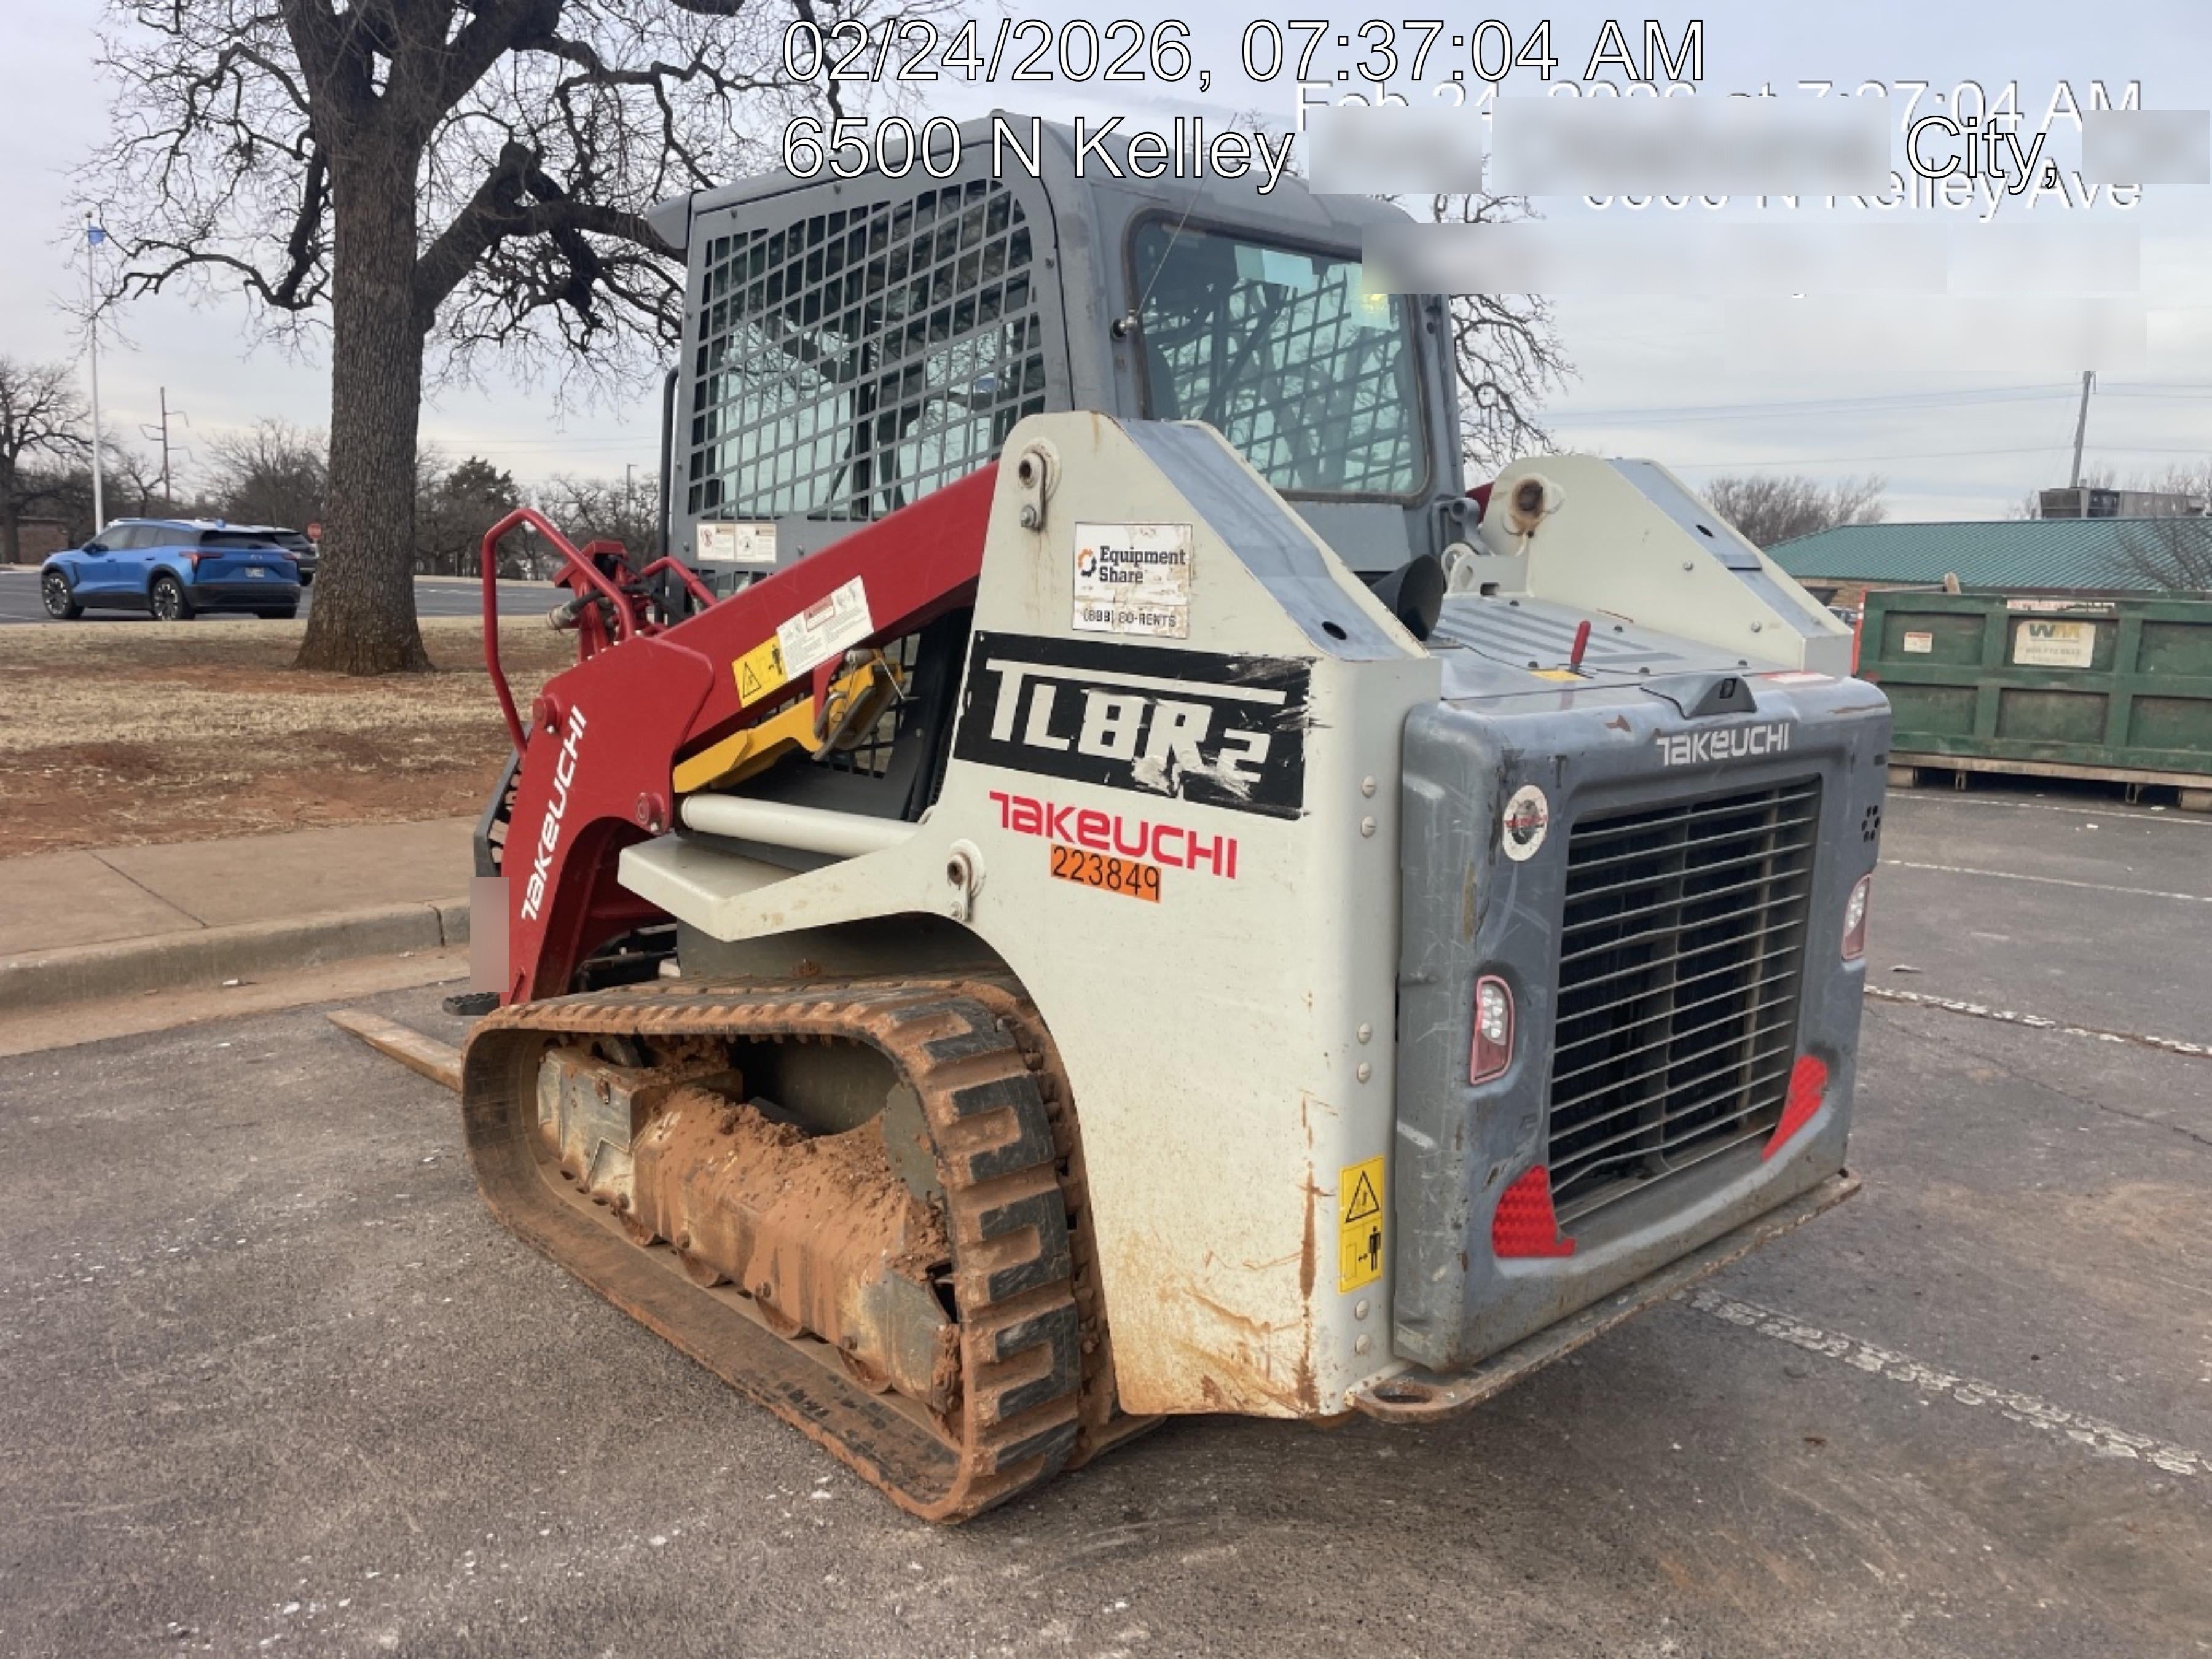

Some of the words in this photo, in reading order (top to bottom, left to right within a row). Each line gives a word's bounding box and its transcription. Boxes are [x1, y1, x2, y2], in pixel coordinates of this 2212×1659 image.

[1099, 545, 1186, 568] Equipment
[1099, 566, 1143, 584] Share
[1053, 846, 1160, 901] 223849
